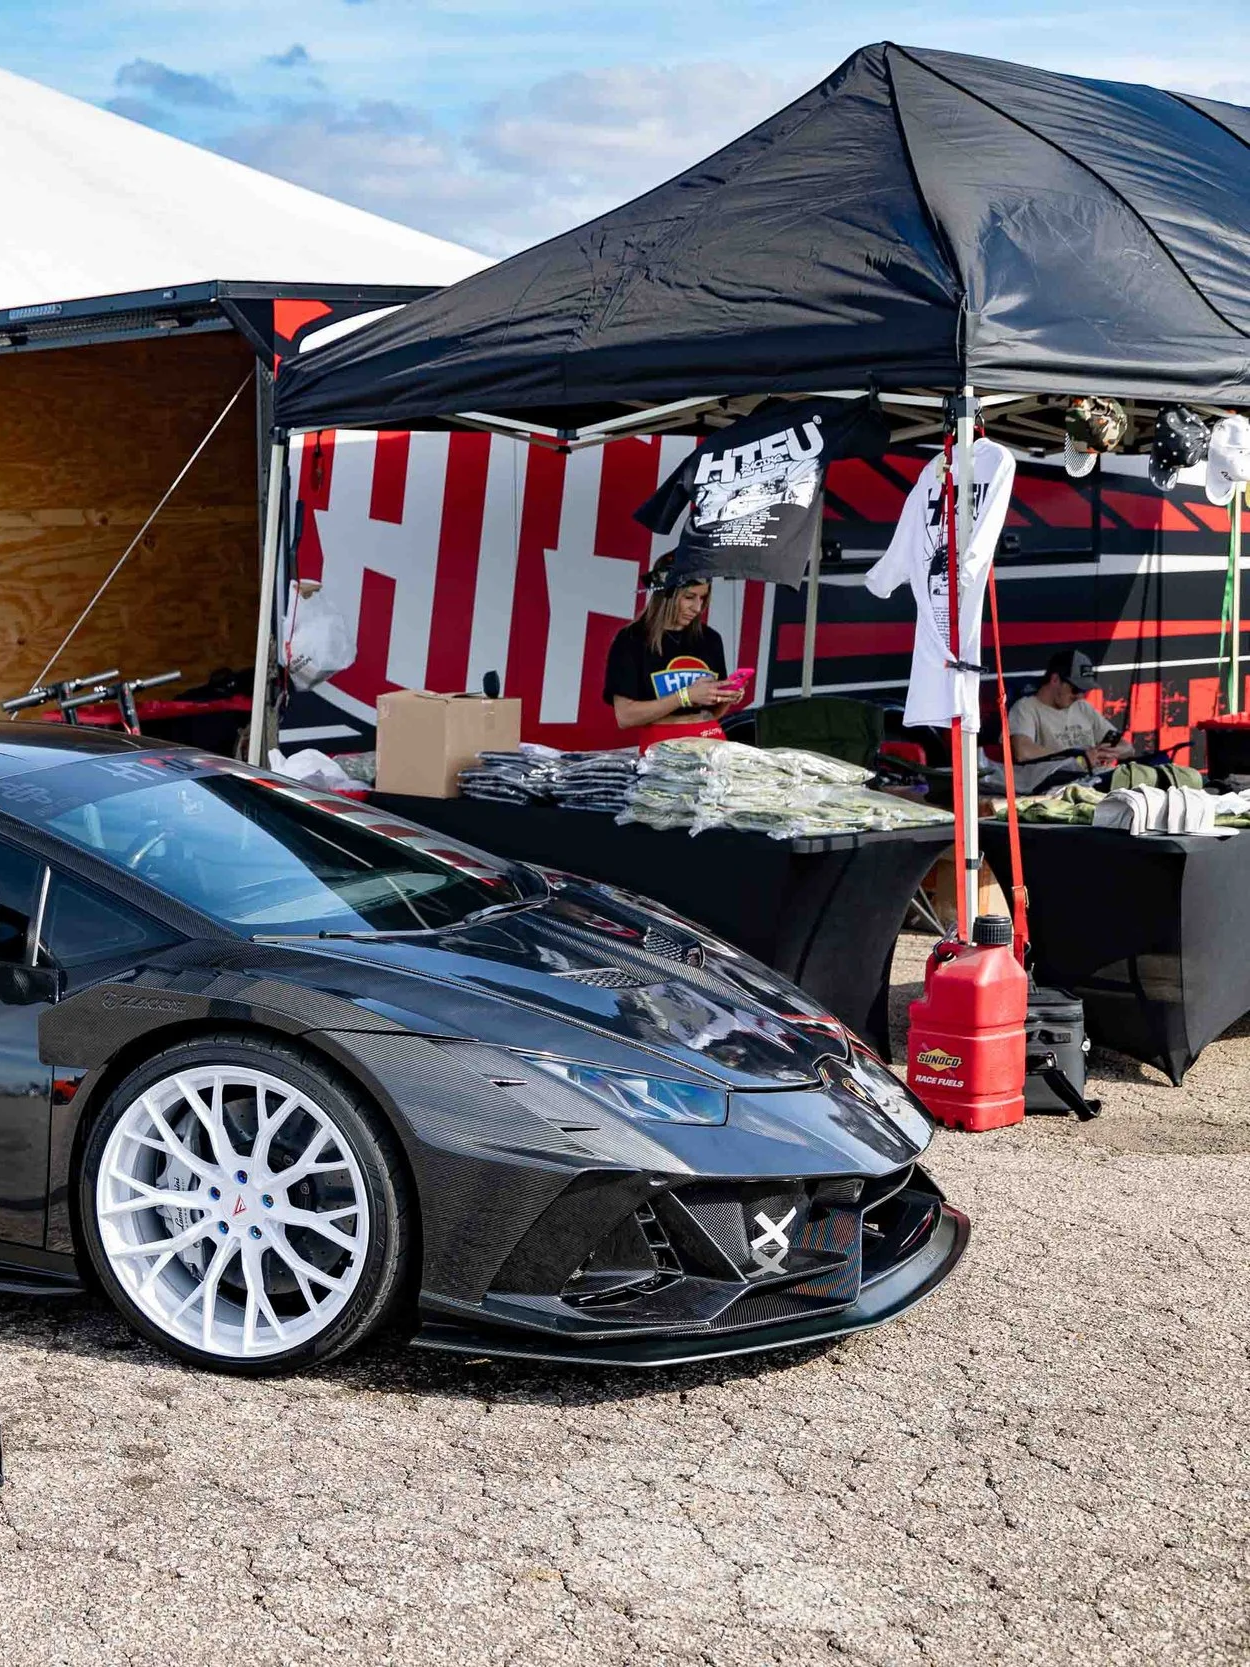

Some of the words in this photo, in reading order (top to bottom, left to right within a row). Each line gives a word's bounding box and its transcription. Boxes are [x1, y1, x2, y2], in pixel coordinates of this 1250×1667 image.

[693, 421, 824, 485] HTFU
[664, 672, 707, 692] HT
[918, 1053, 960, 1067] SUNOCO
[915, 1074, 938, 1084] RACE
[937, 1077, 965, 1088] FUELS
